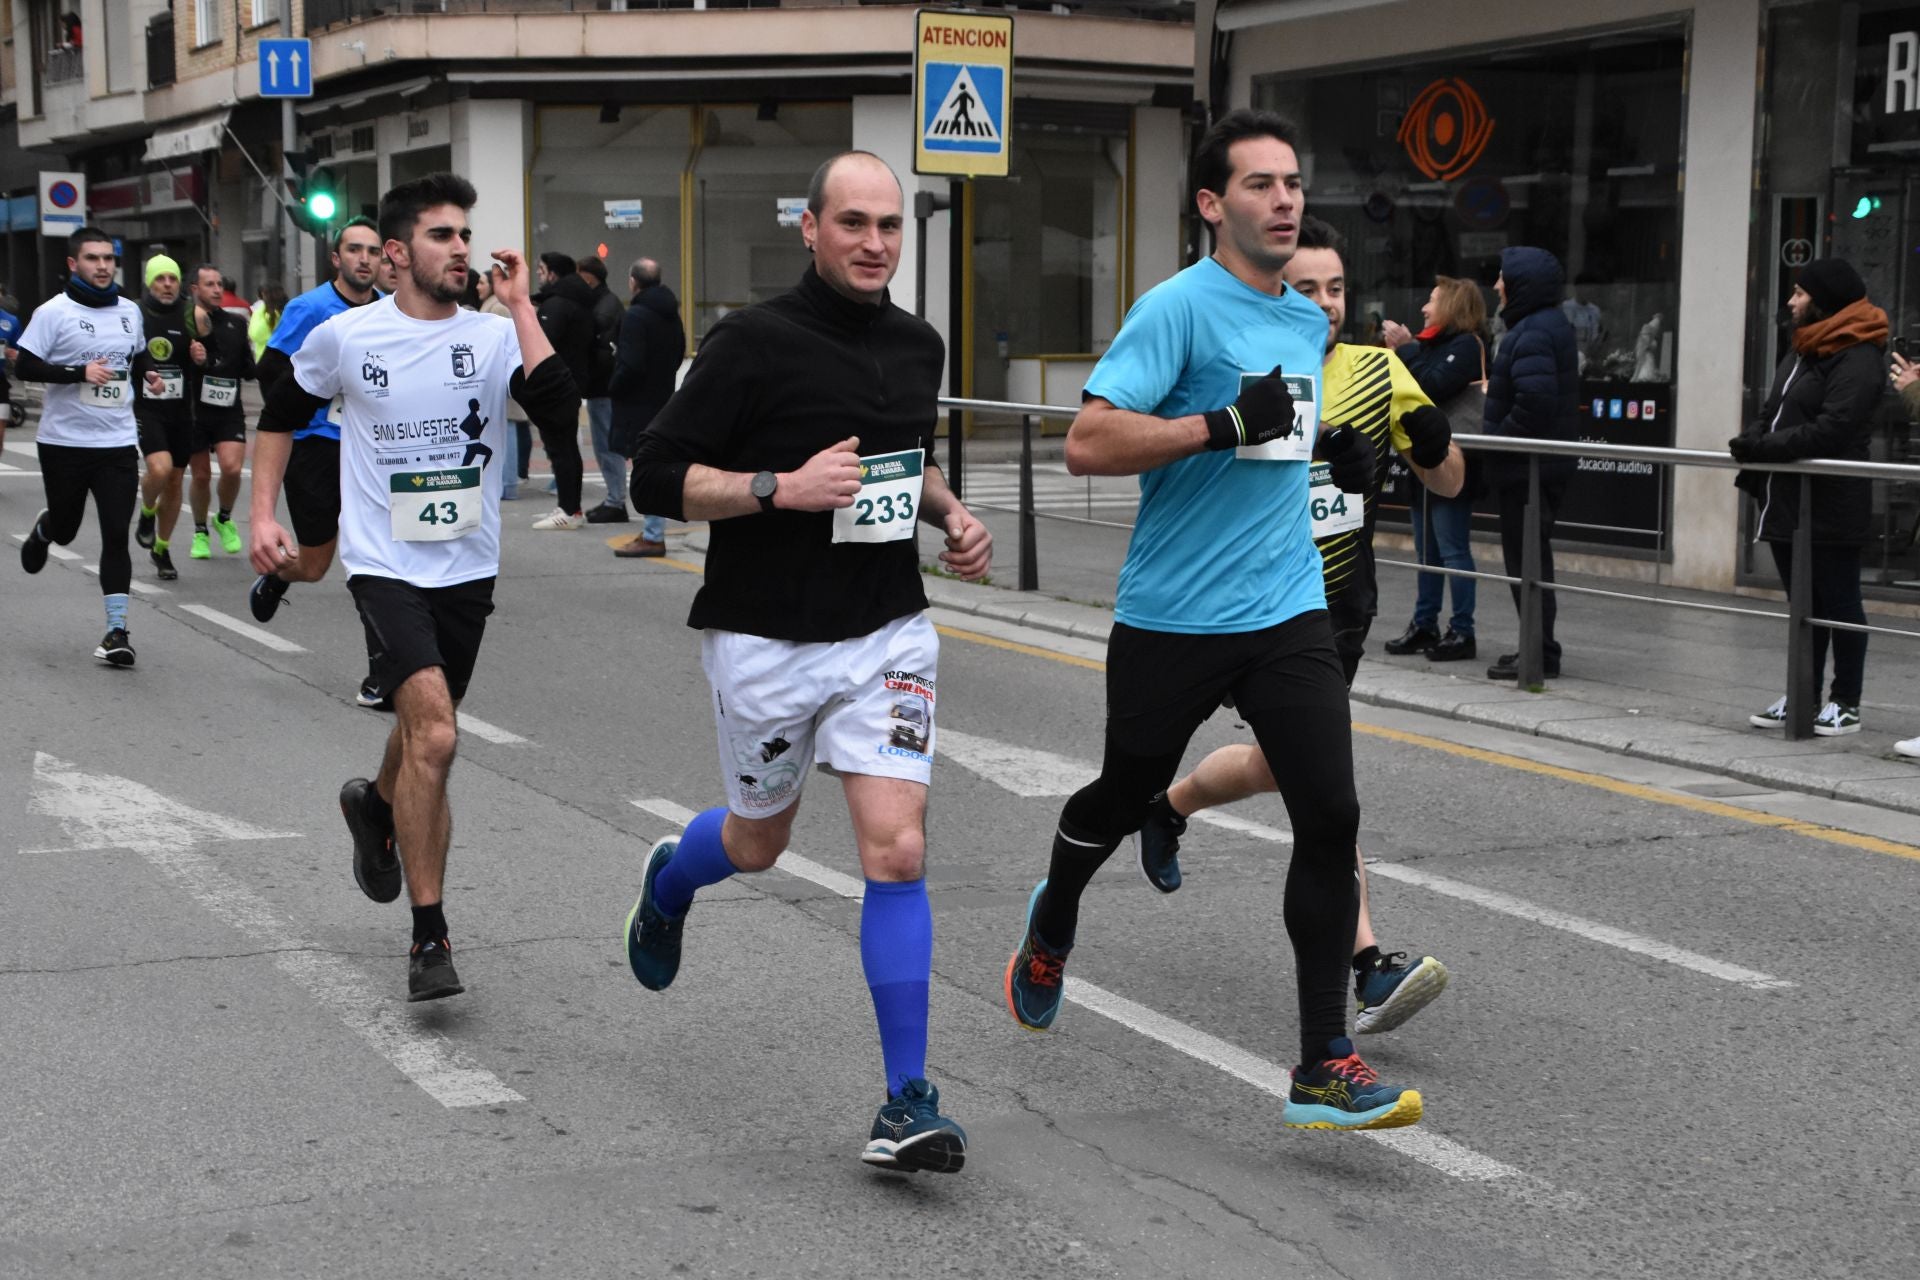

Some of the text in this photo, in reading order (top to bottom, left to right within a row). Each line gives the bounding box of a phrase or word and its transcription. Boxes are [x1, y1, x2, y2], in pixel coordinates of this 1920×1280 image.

[924, 25, 1007, 49] ATENCION
[1885, 30, 1920, 114] R
[91, 386, 121, 399] 150
[208, 390, 231, 401] 207
[373, 417, 459, 440] SAN SILVESTRE
[428, 453, 446, 461] DESDE
[447, 452, 460, 460] 1977
[870, 463, 885, 471] CAJA
[1617, 461, 1653, 475] auditiva
[419, 501, 459, 525] 43
[855, 491, 914, 526] 233
[1310, 493, 1348, 521] 64
